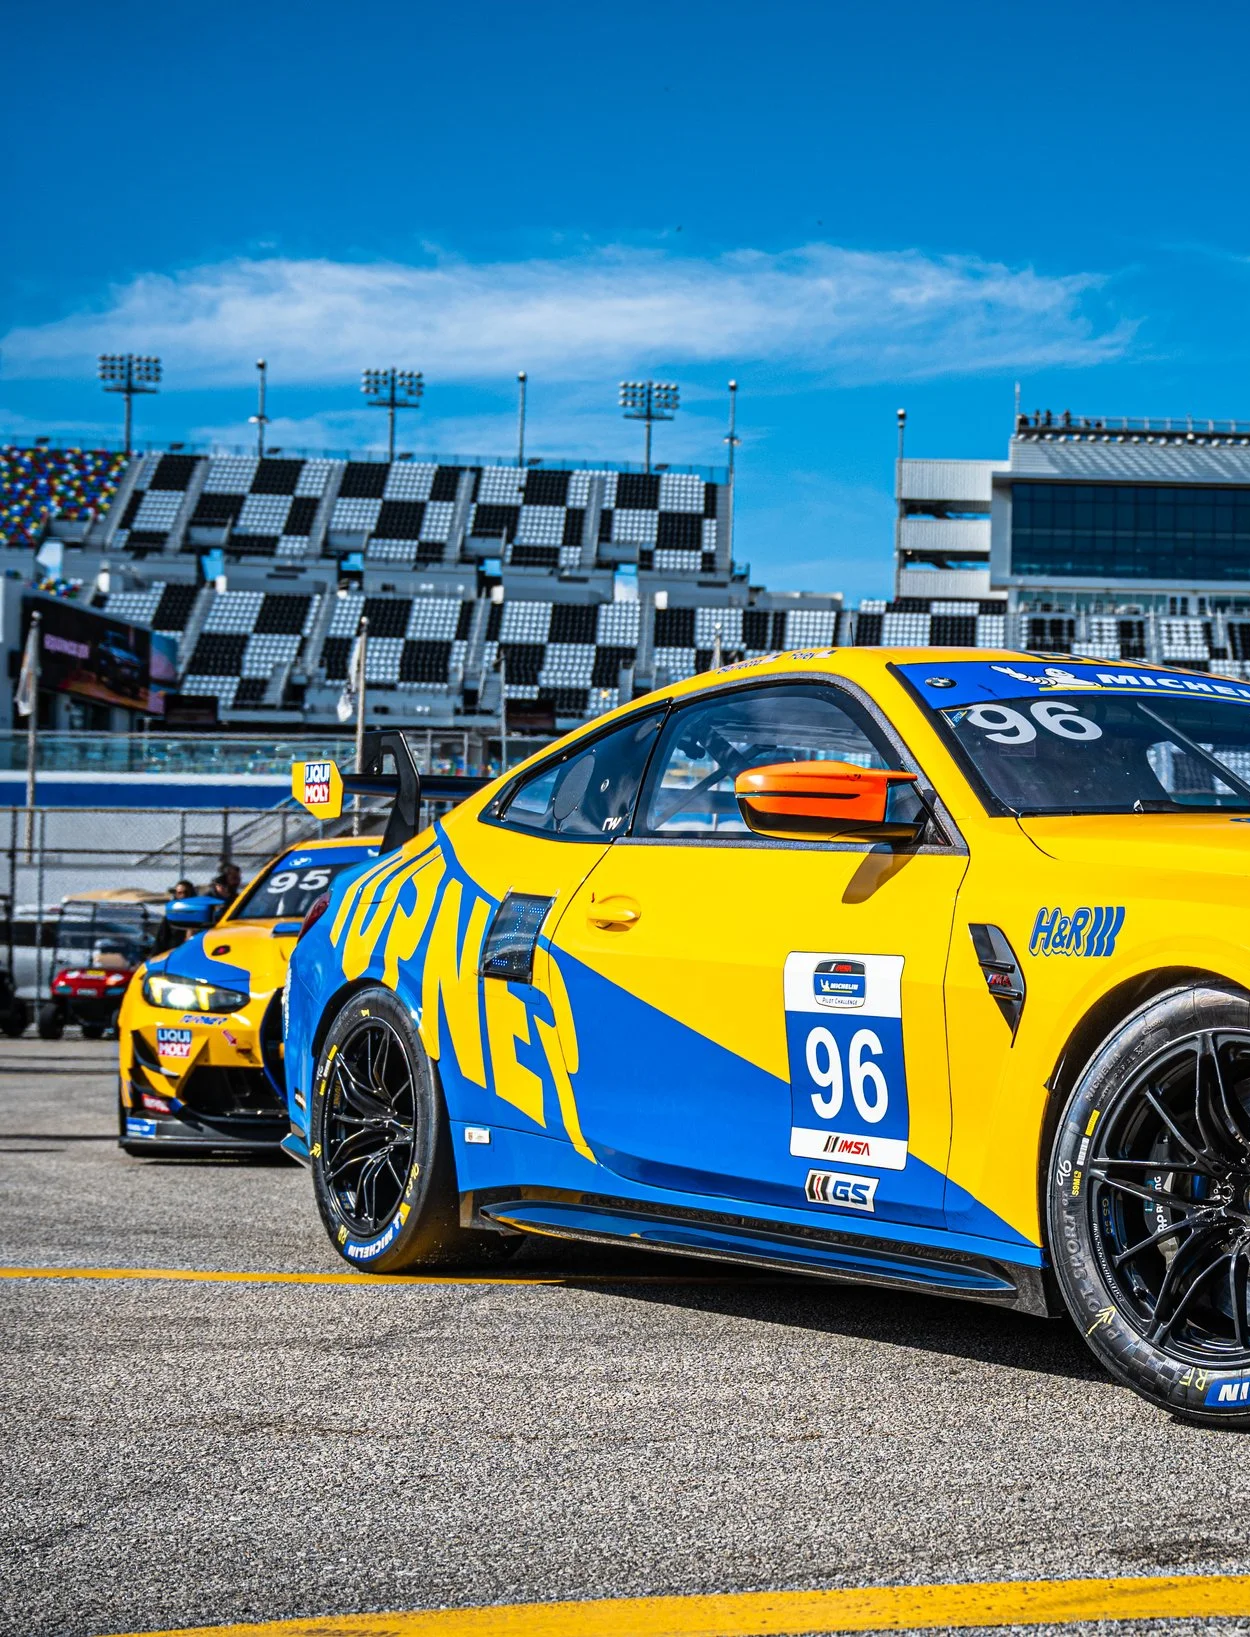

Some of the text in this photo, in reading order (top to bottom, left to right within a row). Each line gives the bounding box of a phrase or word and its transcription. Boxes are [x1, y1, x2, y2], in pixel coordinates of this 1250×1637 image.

[966, 701, 1103, 745] 96
[305, 784, 329, 803] MOLY
[267, 869, 331, 894] 95
[158, 1029, 191, 1043] LIQUI
[158, 1043, 191, 1057] MOLY
[805, 1026, 889, 1124] 96
[837, 1139, 870, 1156] IMSA
[1056, 1159, 1072, 1187] 96
[831, 1180, 871, 1206] GS
[348, 1227, 393, 1259] MICHELIN
